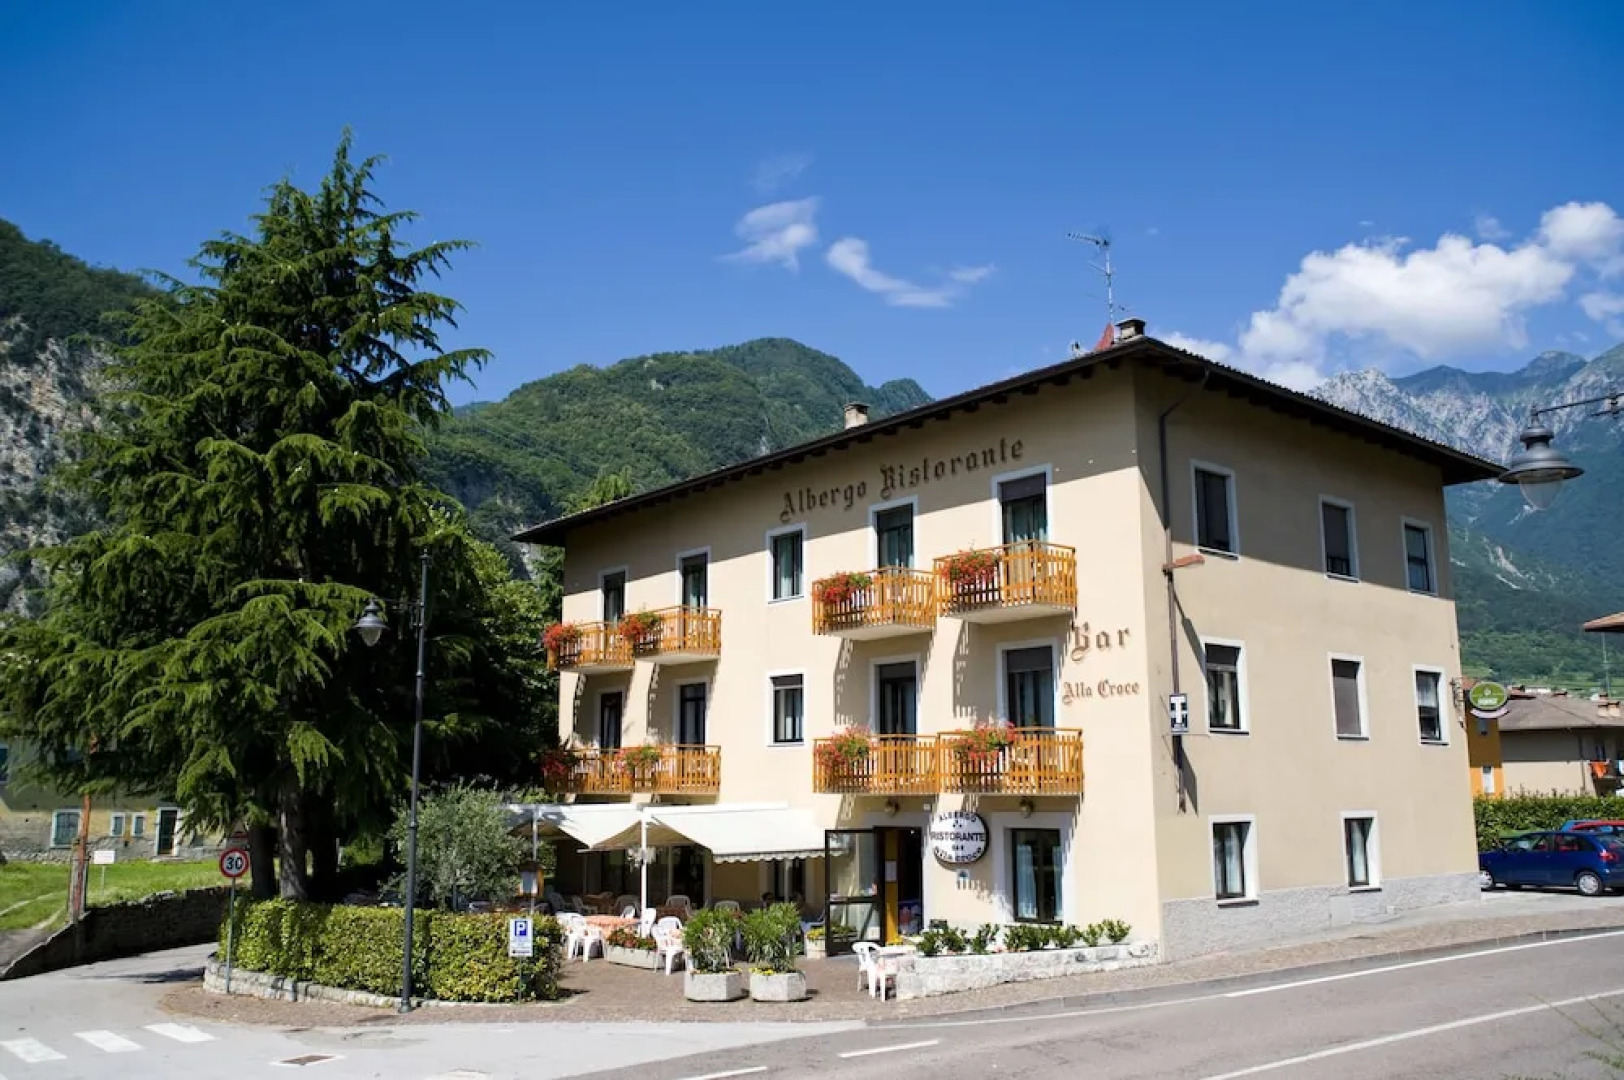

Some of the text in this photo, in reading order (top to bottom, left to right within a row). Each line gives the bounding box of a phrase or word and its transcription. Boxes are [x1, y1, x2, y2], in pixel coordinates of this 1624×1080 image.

[779, 437, 1024, 523] Albergo Ristorante
[1071, 621, 1130, 662] Bar
[1062, 679, 1141, 705] Alla Croce
[930, 831, 986, 842] RISTORANTE
[226, 856, 243, 870] 30
[516, 922, 525, 936] P
